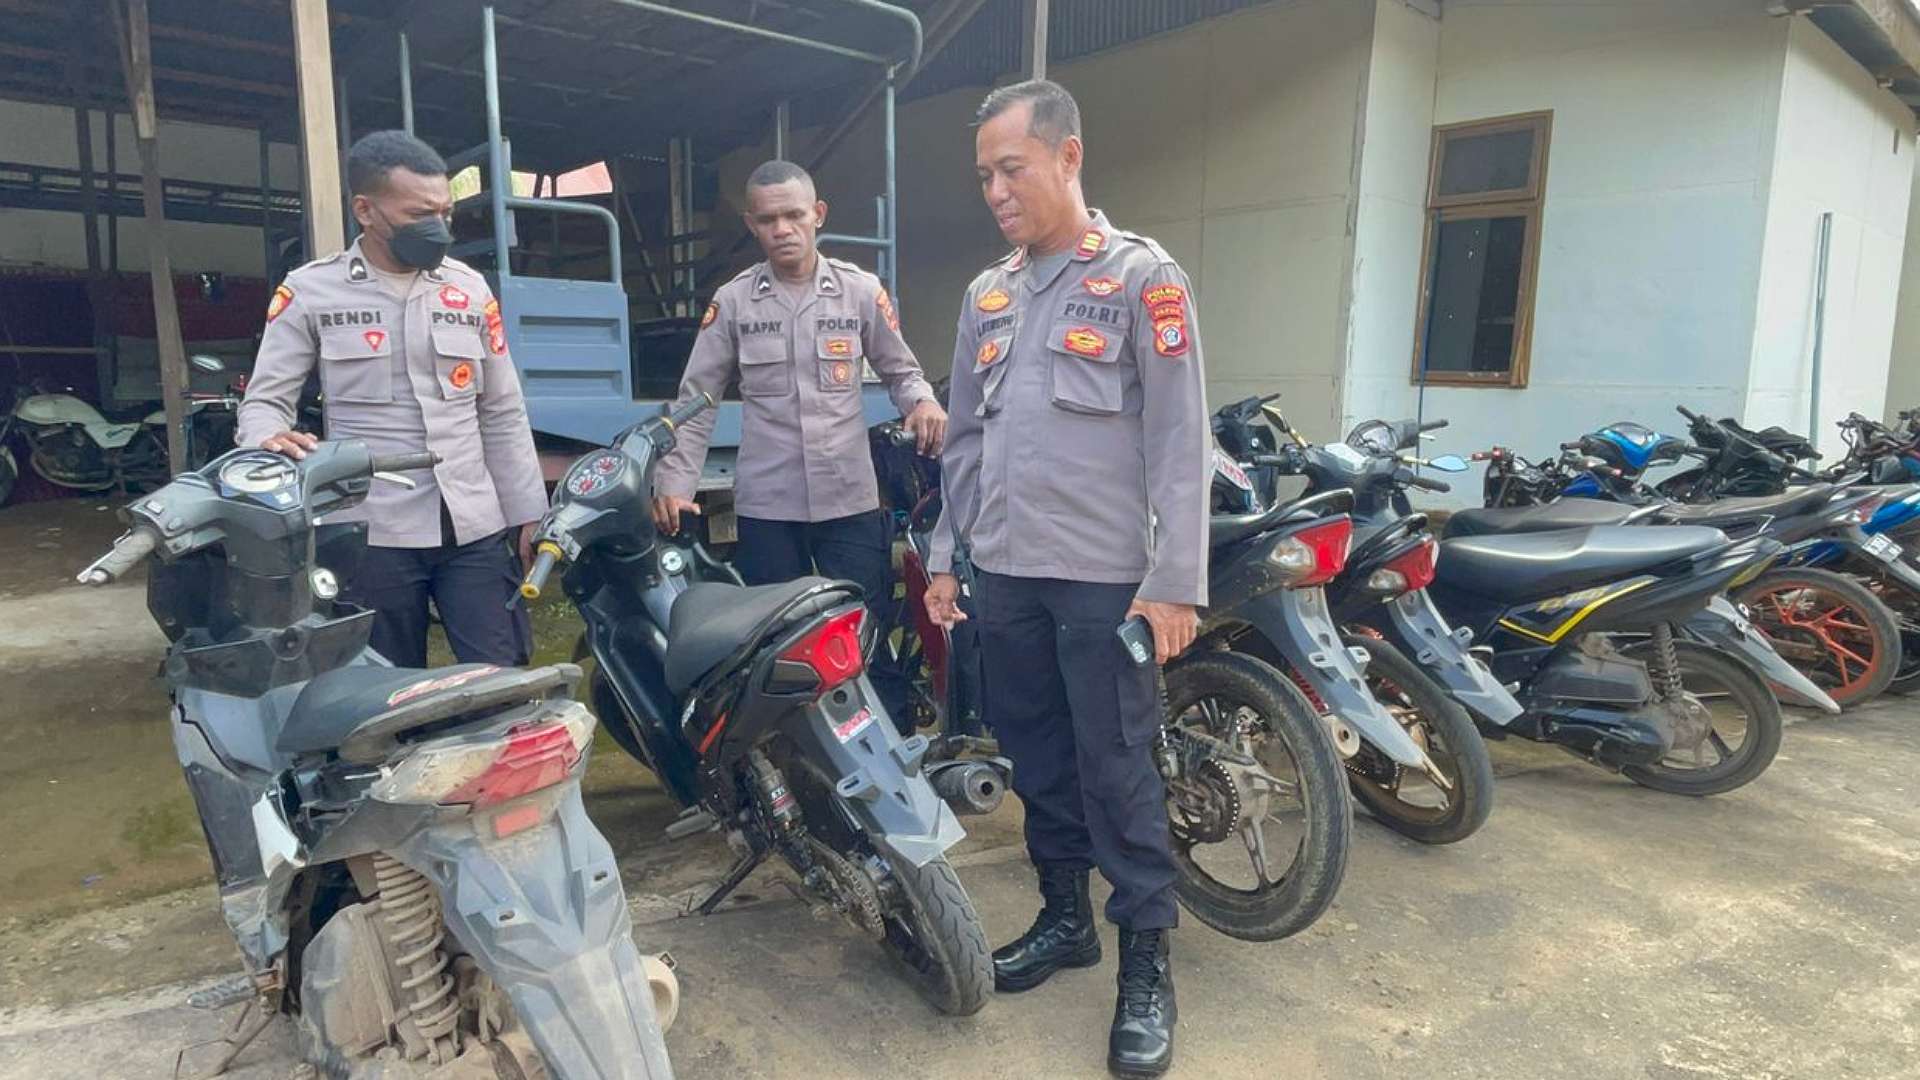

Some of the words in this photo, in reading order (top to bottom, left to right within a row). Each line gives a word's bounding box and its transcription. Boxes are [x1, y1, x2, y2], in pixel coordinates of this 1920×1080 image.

[320, 311, 382, 327] RENDI
[432, 311, 481, 327] POLRI
[1063, 303, 1121, 324] POLRI
[740, 321, 783, 336] W.APAY
[817, 318, 859, 332] POLRI
